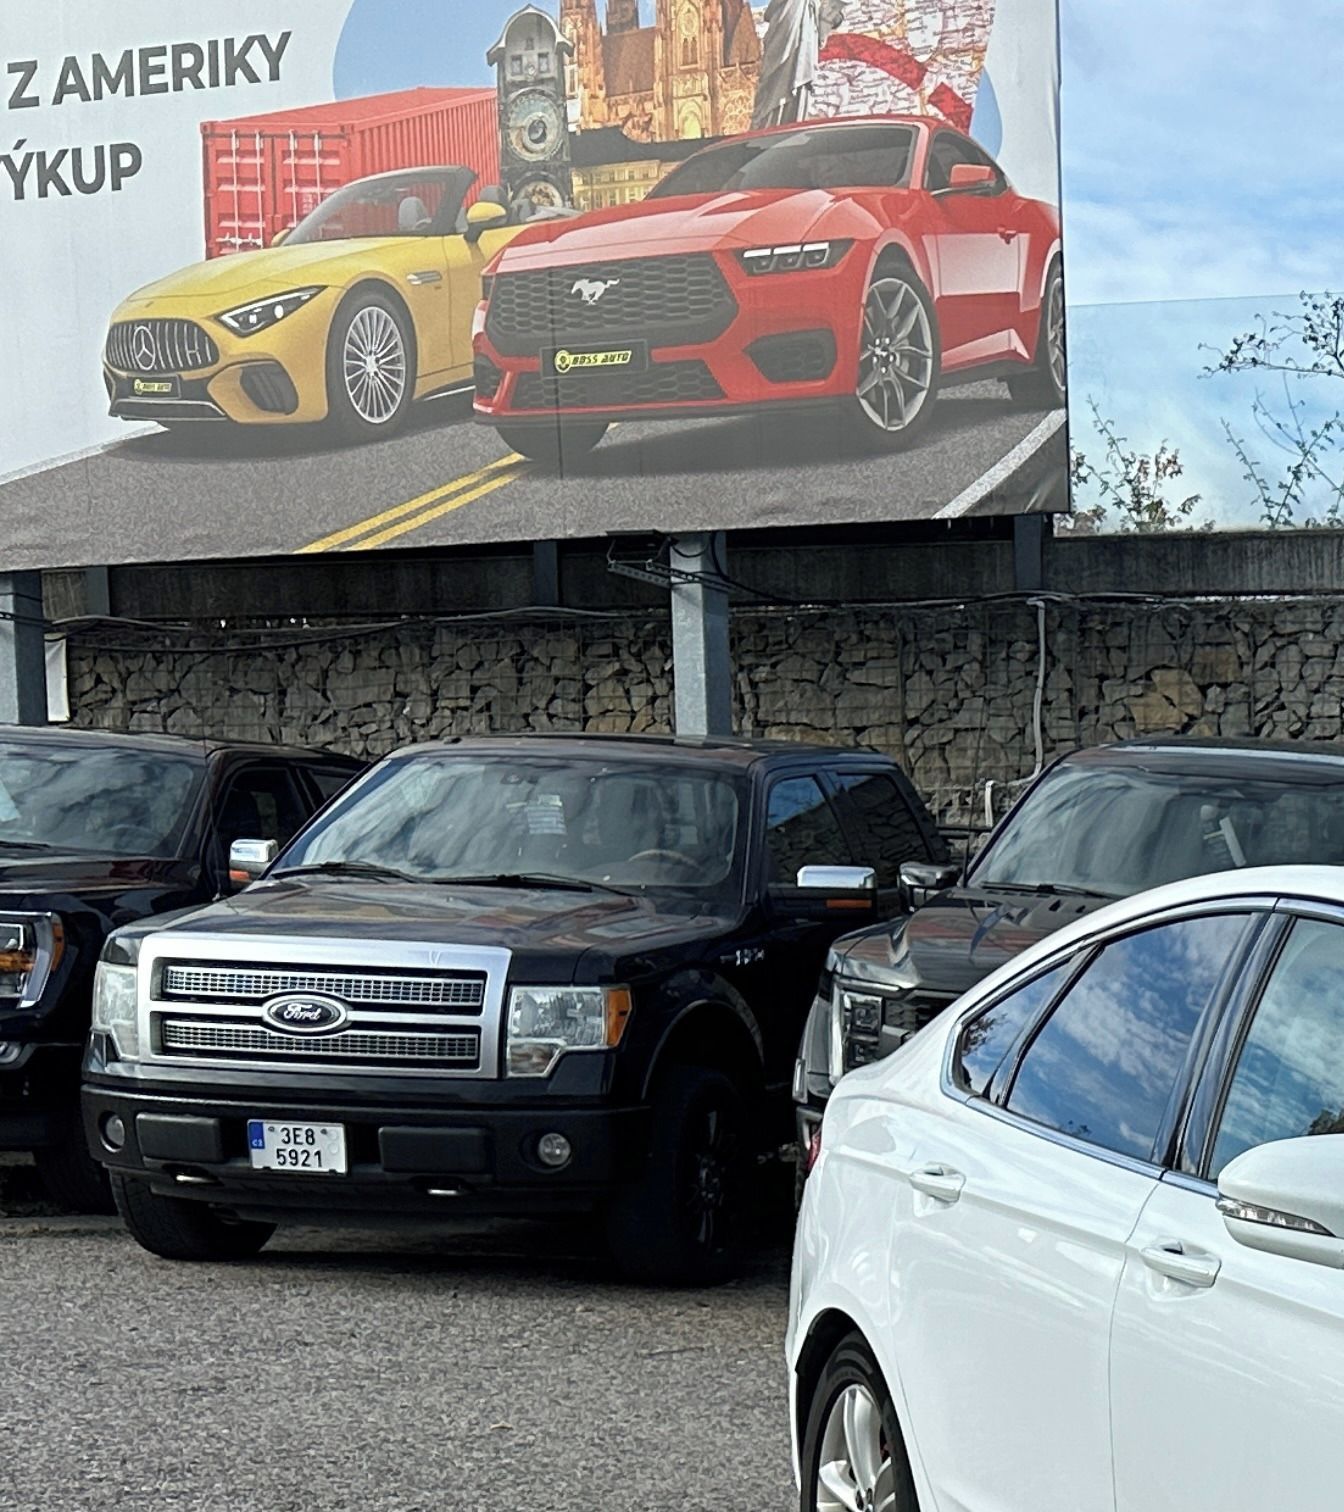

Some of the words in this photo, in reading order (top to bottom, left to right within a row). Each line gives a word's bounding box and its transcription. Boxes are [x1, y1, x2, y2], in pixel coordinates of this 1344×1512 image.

[7, 59, 40, 110] Z
[51, 30, 292, 106] AMERIKY
[571, 354, 599, 365] BOSS
[601, 352, 630, 363] AUTO
[283, 1003, 322, 1020] Ford
[280, 1127, 316, 1146] 3E8
[276, 1148, 322, 1168] 5921
